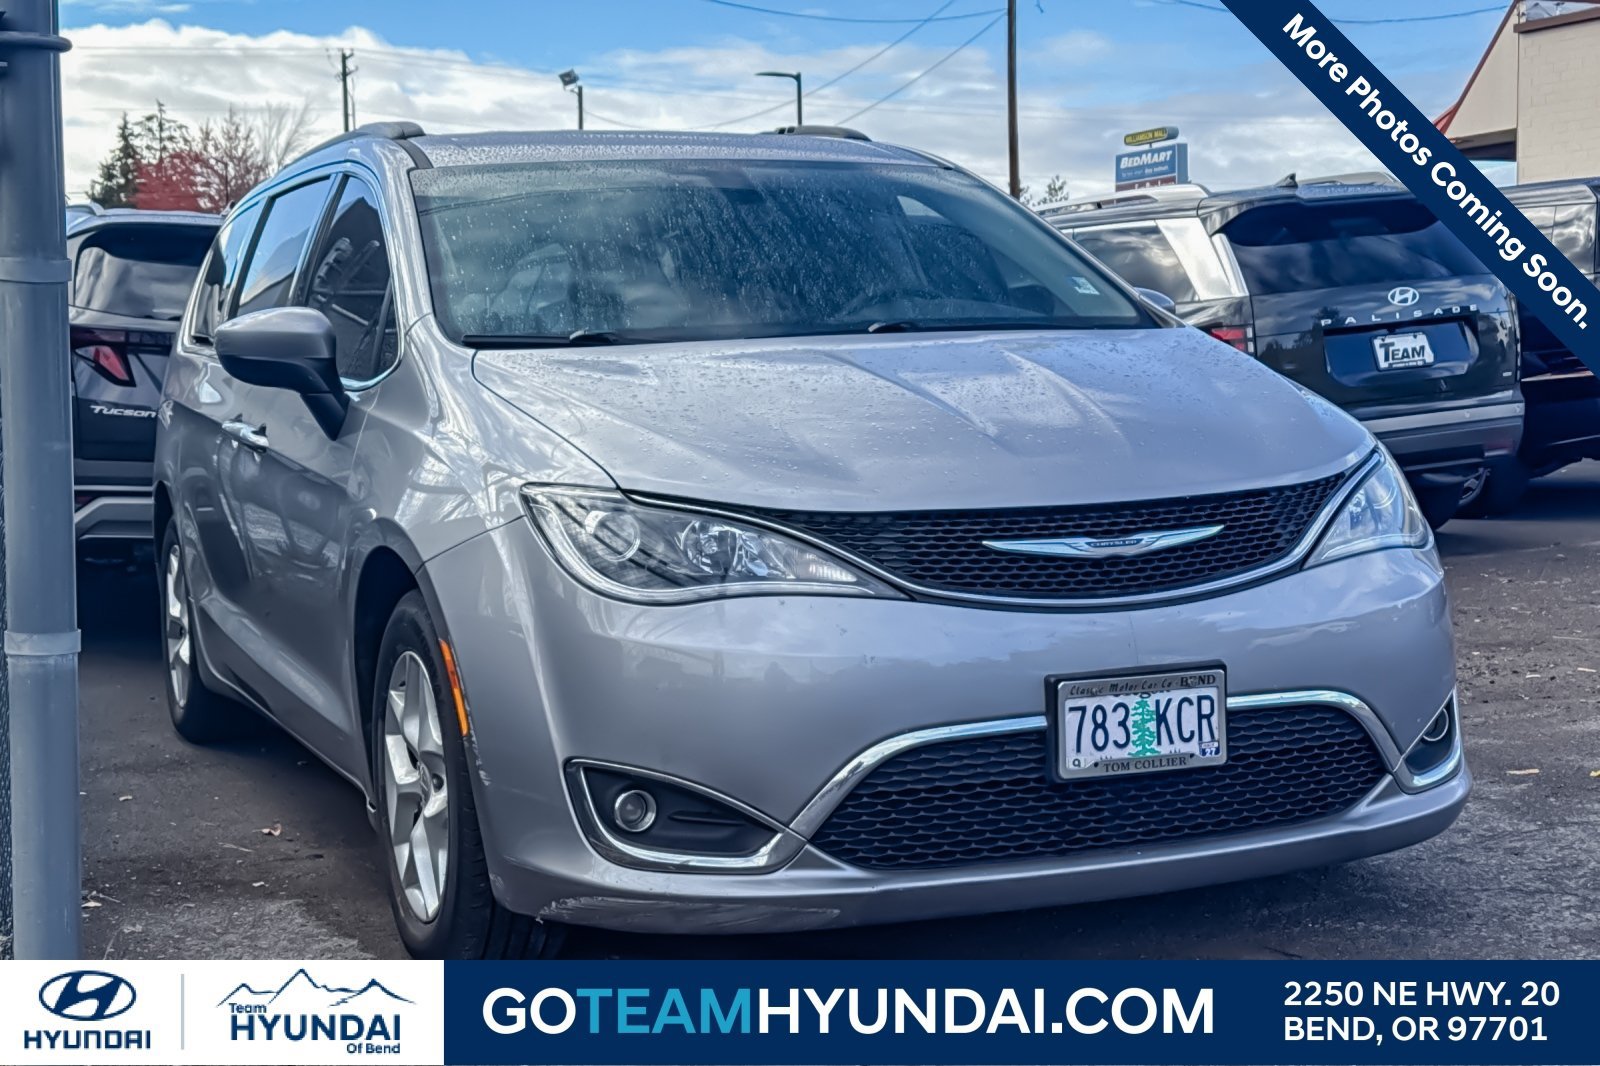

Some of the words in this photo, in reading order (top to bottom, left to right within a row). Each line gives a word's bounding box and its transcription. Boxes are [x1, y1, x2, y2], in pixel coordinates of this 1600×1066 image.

[1321, 304, 1478, 327] PALISADE
[1109, 682, 1137, 693] Motor
[1141, 680, 1158, 690] Car
[1068, 702, 1132, 754] 783
[1155, 694, 1216, 746] KCR
[1205, 747, 1216, 756] 27
[1104, 761, 1131, 773] TOM
[1134, 756, 1187, 770] COLLIER
